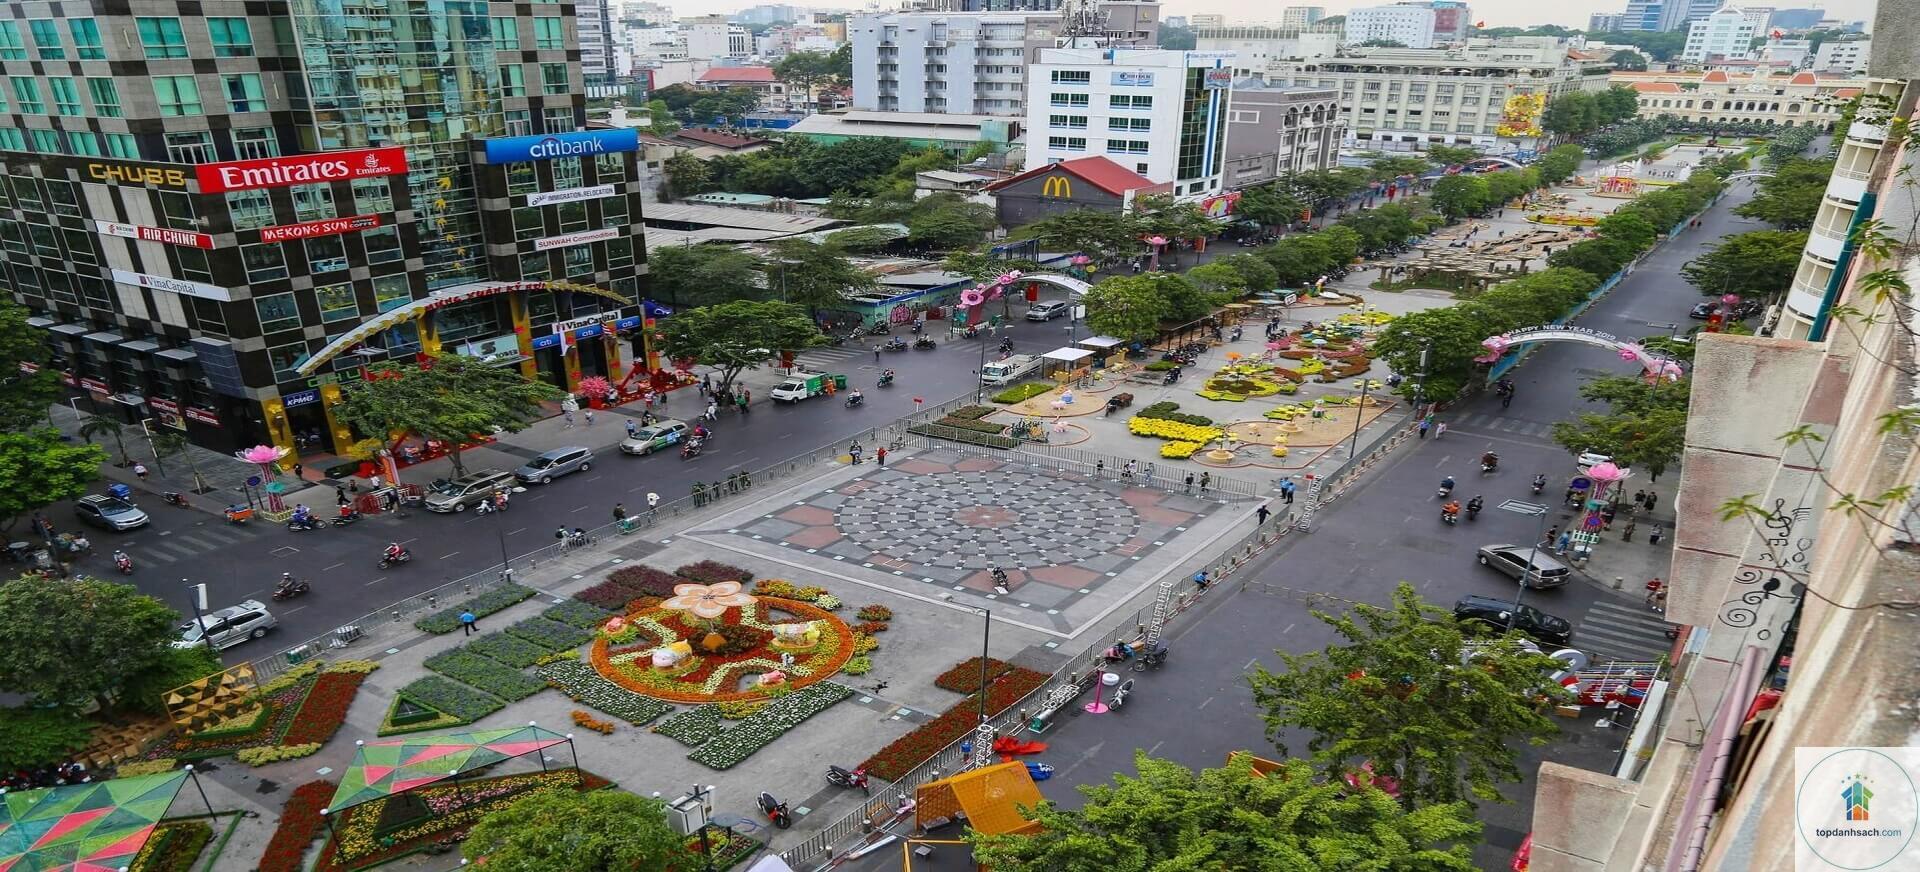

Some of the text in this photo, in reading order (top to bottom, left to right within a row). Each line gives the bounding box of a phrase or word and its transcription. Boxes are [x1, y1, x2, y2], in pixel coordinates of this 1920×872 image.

[530, 136, 603, 158] citibank
[89, 164, 186, 186] CHUBB
[219, 160, 349, 188] Emirates
[355, 165, 391, 175] Emirates
[143, 228, 197, 246] AIR CHINA
[264, 221, 347, 239] MEKONG SUN
[538, 231, 617, 248] SUNWAH Commodities
[147, 276, 196, 294] VinaCapital
[1507, 325, 1539, 336] HAPPY
[1568, 326, 1593, 334] YEAR
[1595, 330, 1616, 340] 2019
[287, 395, 313, 406] KPMG
